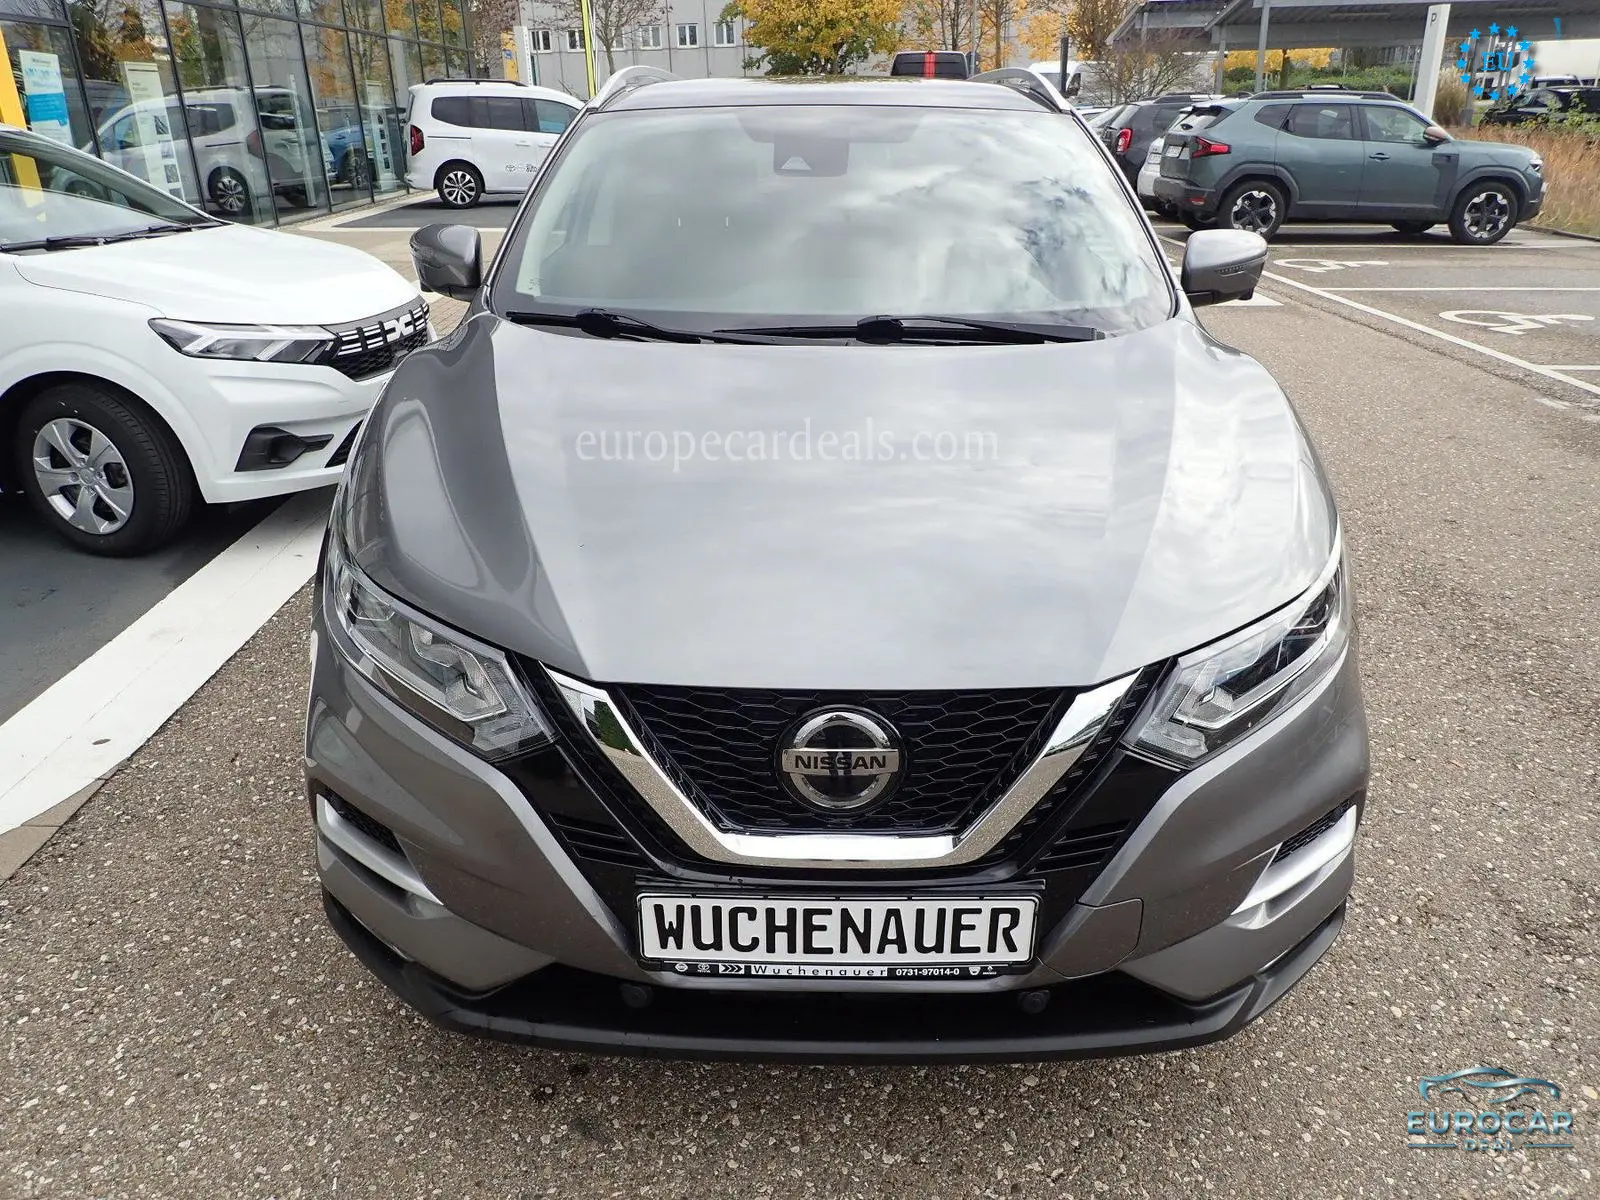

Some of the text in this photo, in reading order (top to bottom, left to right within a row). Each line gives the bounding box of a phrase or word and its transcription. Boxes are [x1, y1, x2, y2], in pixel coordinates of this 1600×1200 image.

[795, 755, 887, 769] NISSAN
[653, 904, 1021, 954] WUCHENAUER
[753, 965, 960, 976] Wuchenauer 0731-97014-0
